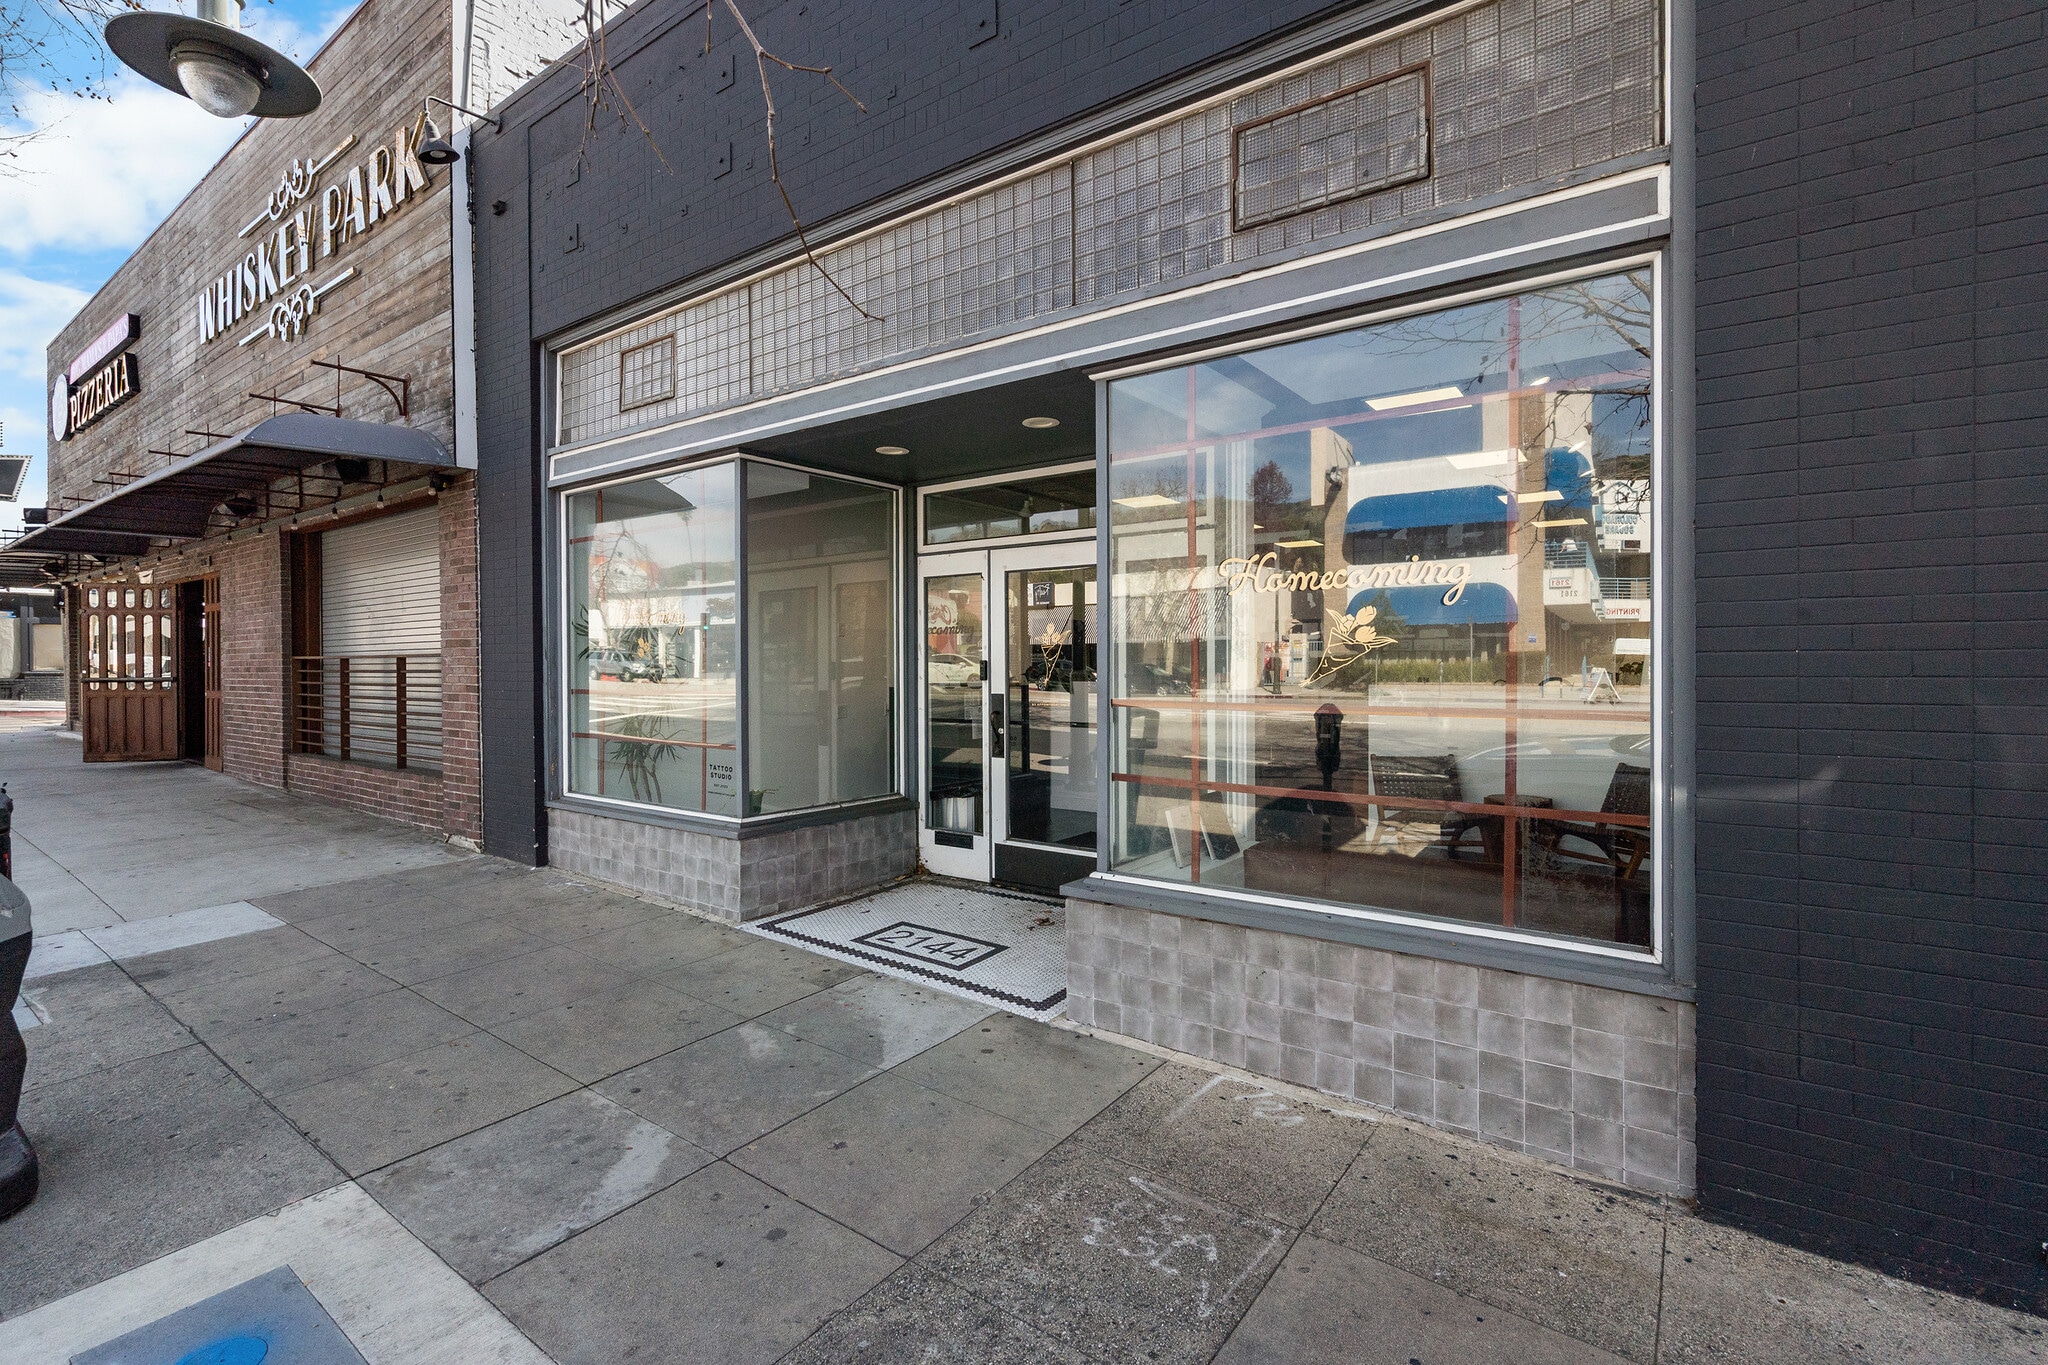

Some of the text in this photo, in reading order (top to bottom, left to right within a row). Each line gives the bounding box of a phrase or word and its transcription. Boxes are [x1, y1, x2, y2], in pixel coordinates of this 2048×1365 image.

[199, 111, 429, 345] WHISKEY PARK
[69, 354, 129, 433] PIZZERIA
[1218, 552, 1473, 606] Homecoming
[709, 764, 733, 773] TATTOO
[710, 772, 732, 781] STUDIO
[876, 930, 979, 960] 2144
